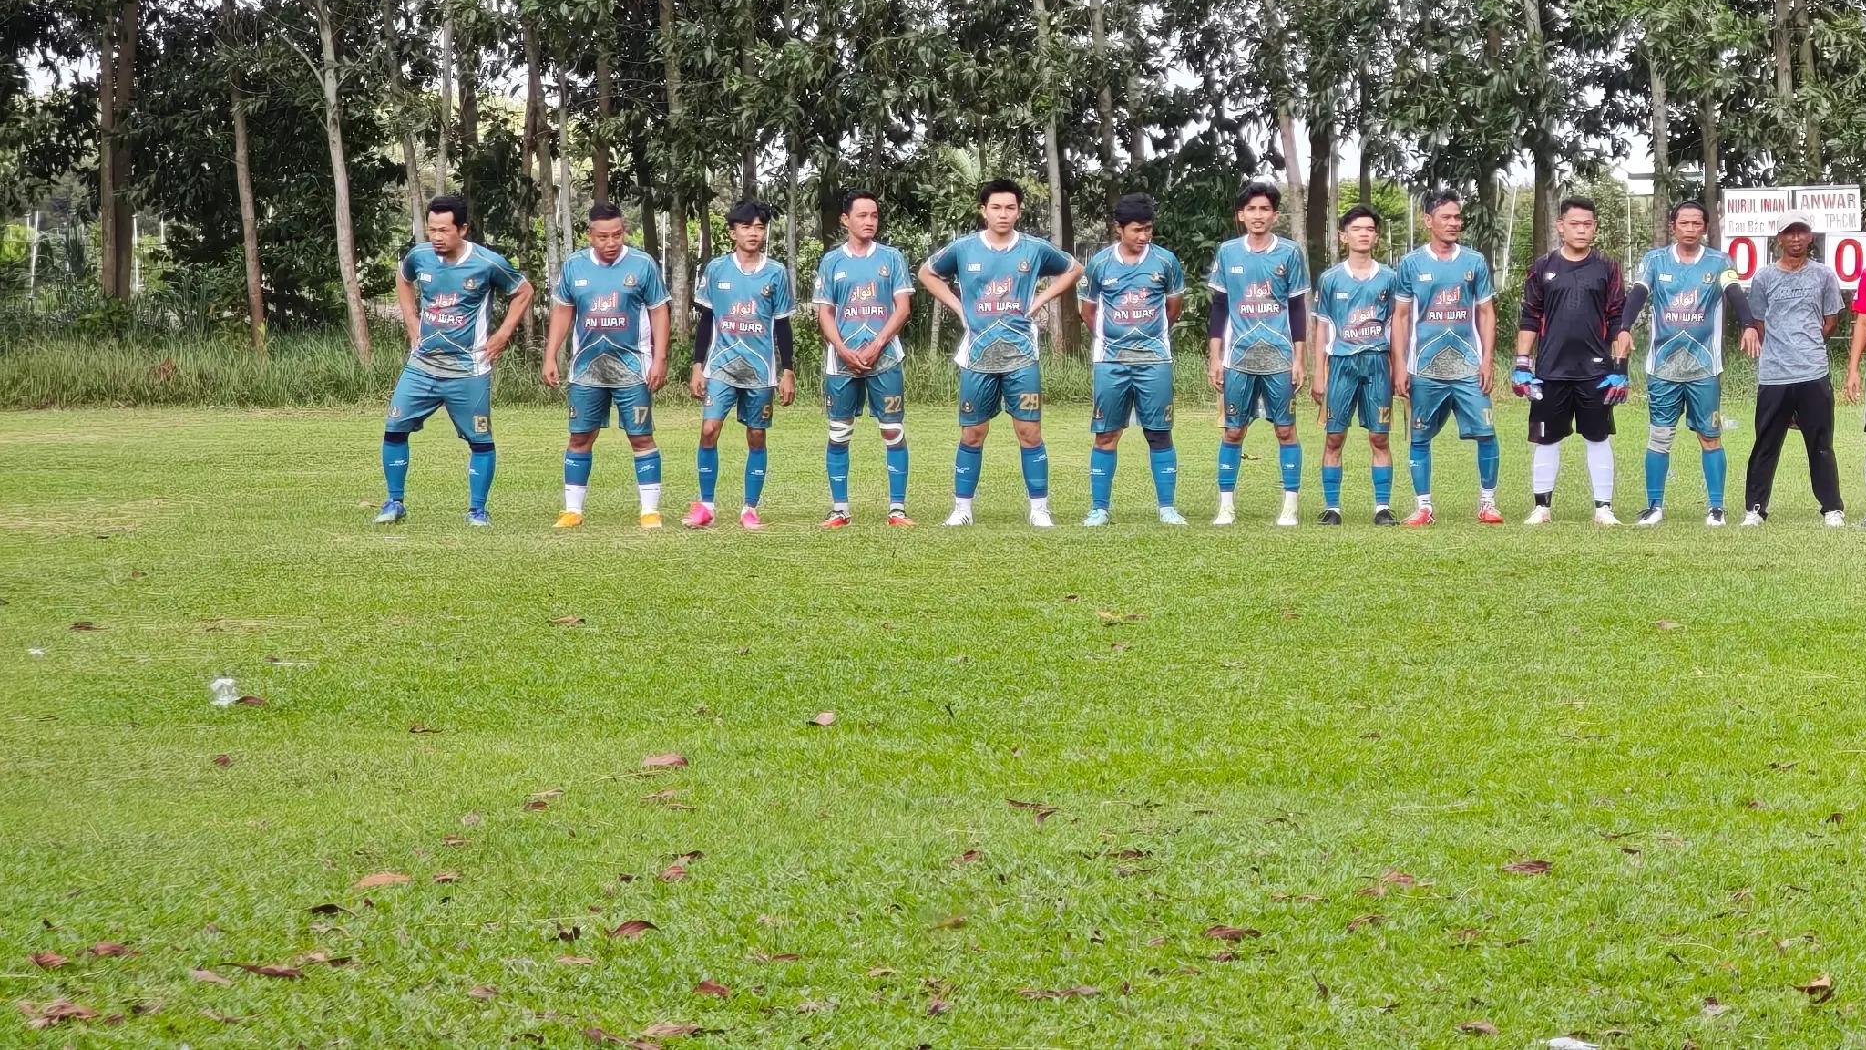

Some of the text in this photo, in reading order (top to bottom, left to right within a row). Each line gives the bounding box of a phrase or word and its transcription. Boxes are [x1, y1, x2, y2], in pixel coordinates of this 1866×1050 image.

[1760, 198, 1785, 213] IMAN
[1800, 193, 1856, 210] ANWAR
[1728, 236, 1757, 281] 0
[1834, 238, 1864, 282] 0
[844, 306, 885, 318] AN WAR
[978, 301, 1021, 312] AN WAR
[1240, 303, 1279, 314] AN WAR
[585, 317, 625, 327] AN WAR
[1665, 312, 1679, 322] AN
[739, 322, 763, 333] WAR
[884, 395, 902, 414] 22
[632, 406, 649, 425] 17
[1378, 406, 1390, 423] 12
